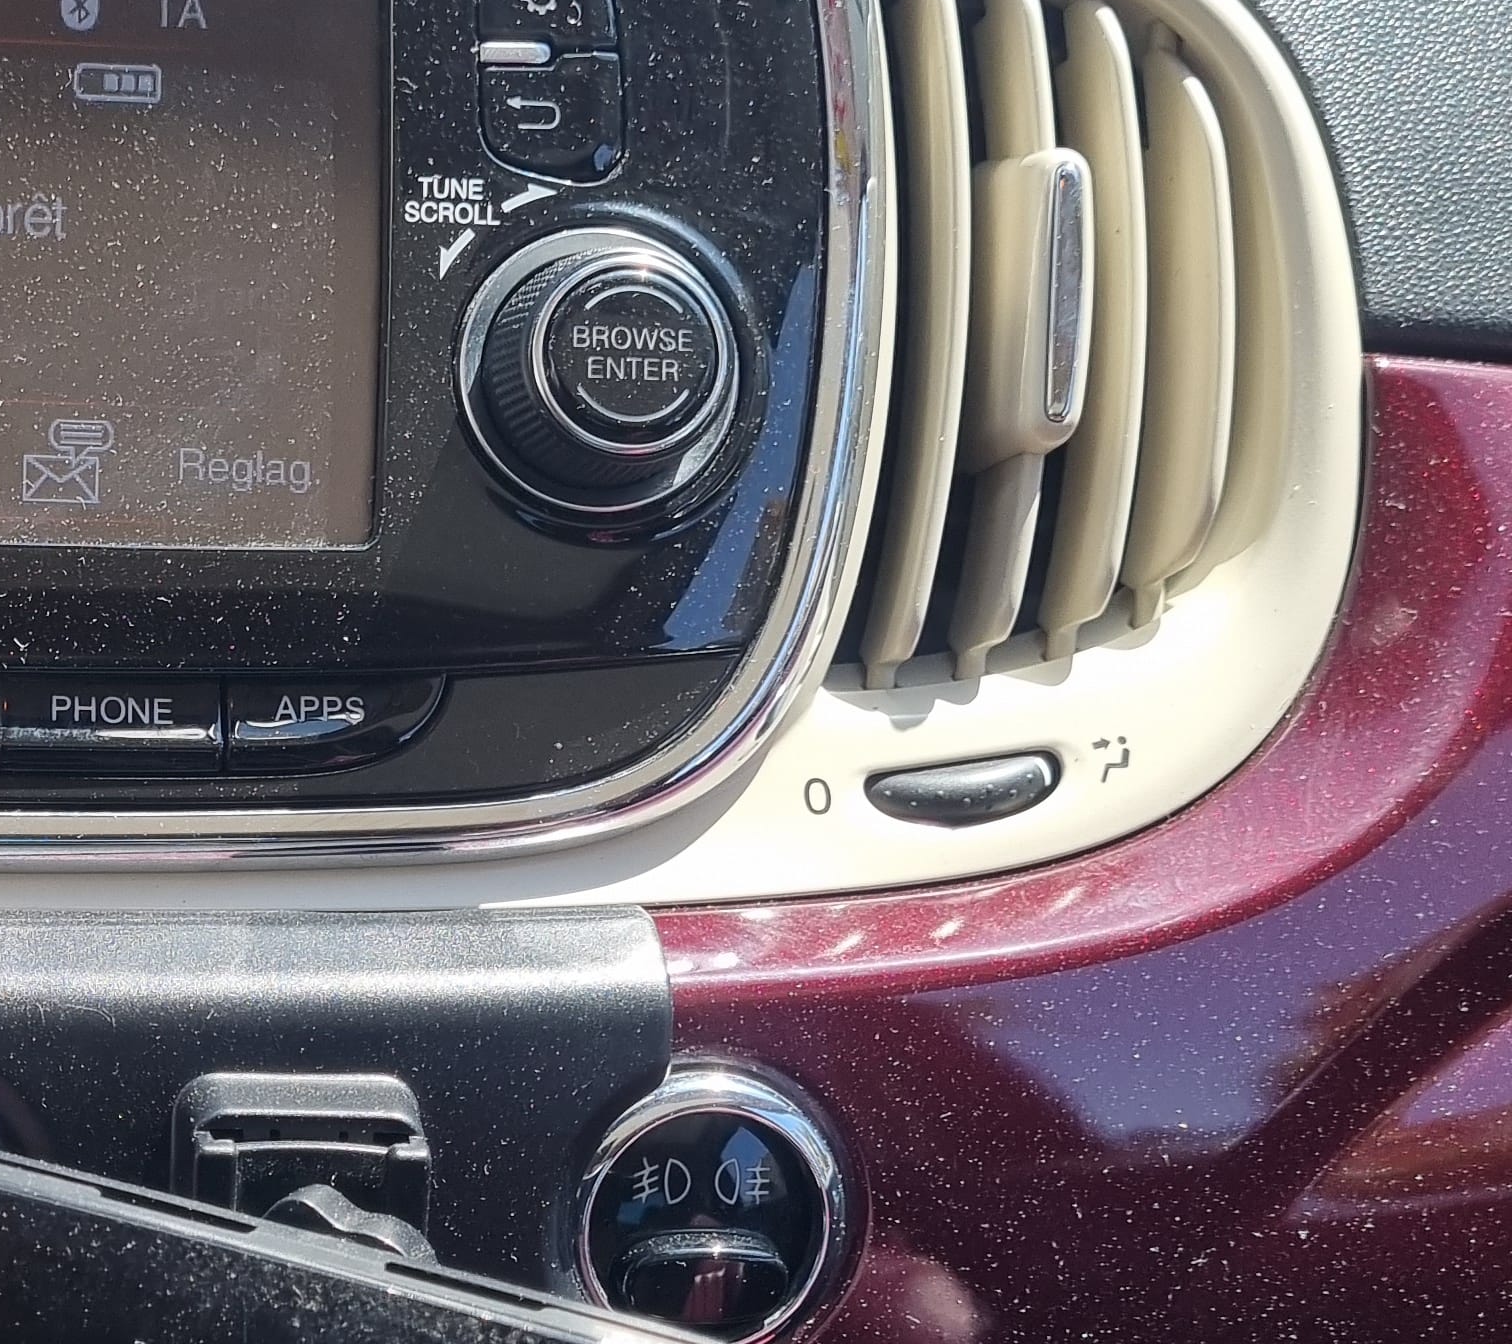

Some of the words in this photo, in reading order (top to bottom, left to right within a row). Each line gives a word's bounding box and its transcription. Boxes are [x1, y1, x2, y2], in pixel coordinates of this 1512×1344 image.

[417, 176, 484, 201] TUNE
[404, 199, 501, 226] SCROLL
[572, 325, 694, 353] BROWSE
[586, 355, 680, 383] ENTER
[50, 695, 174, 725] PHONE
[274, 695, 366, 724] APPS
